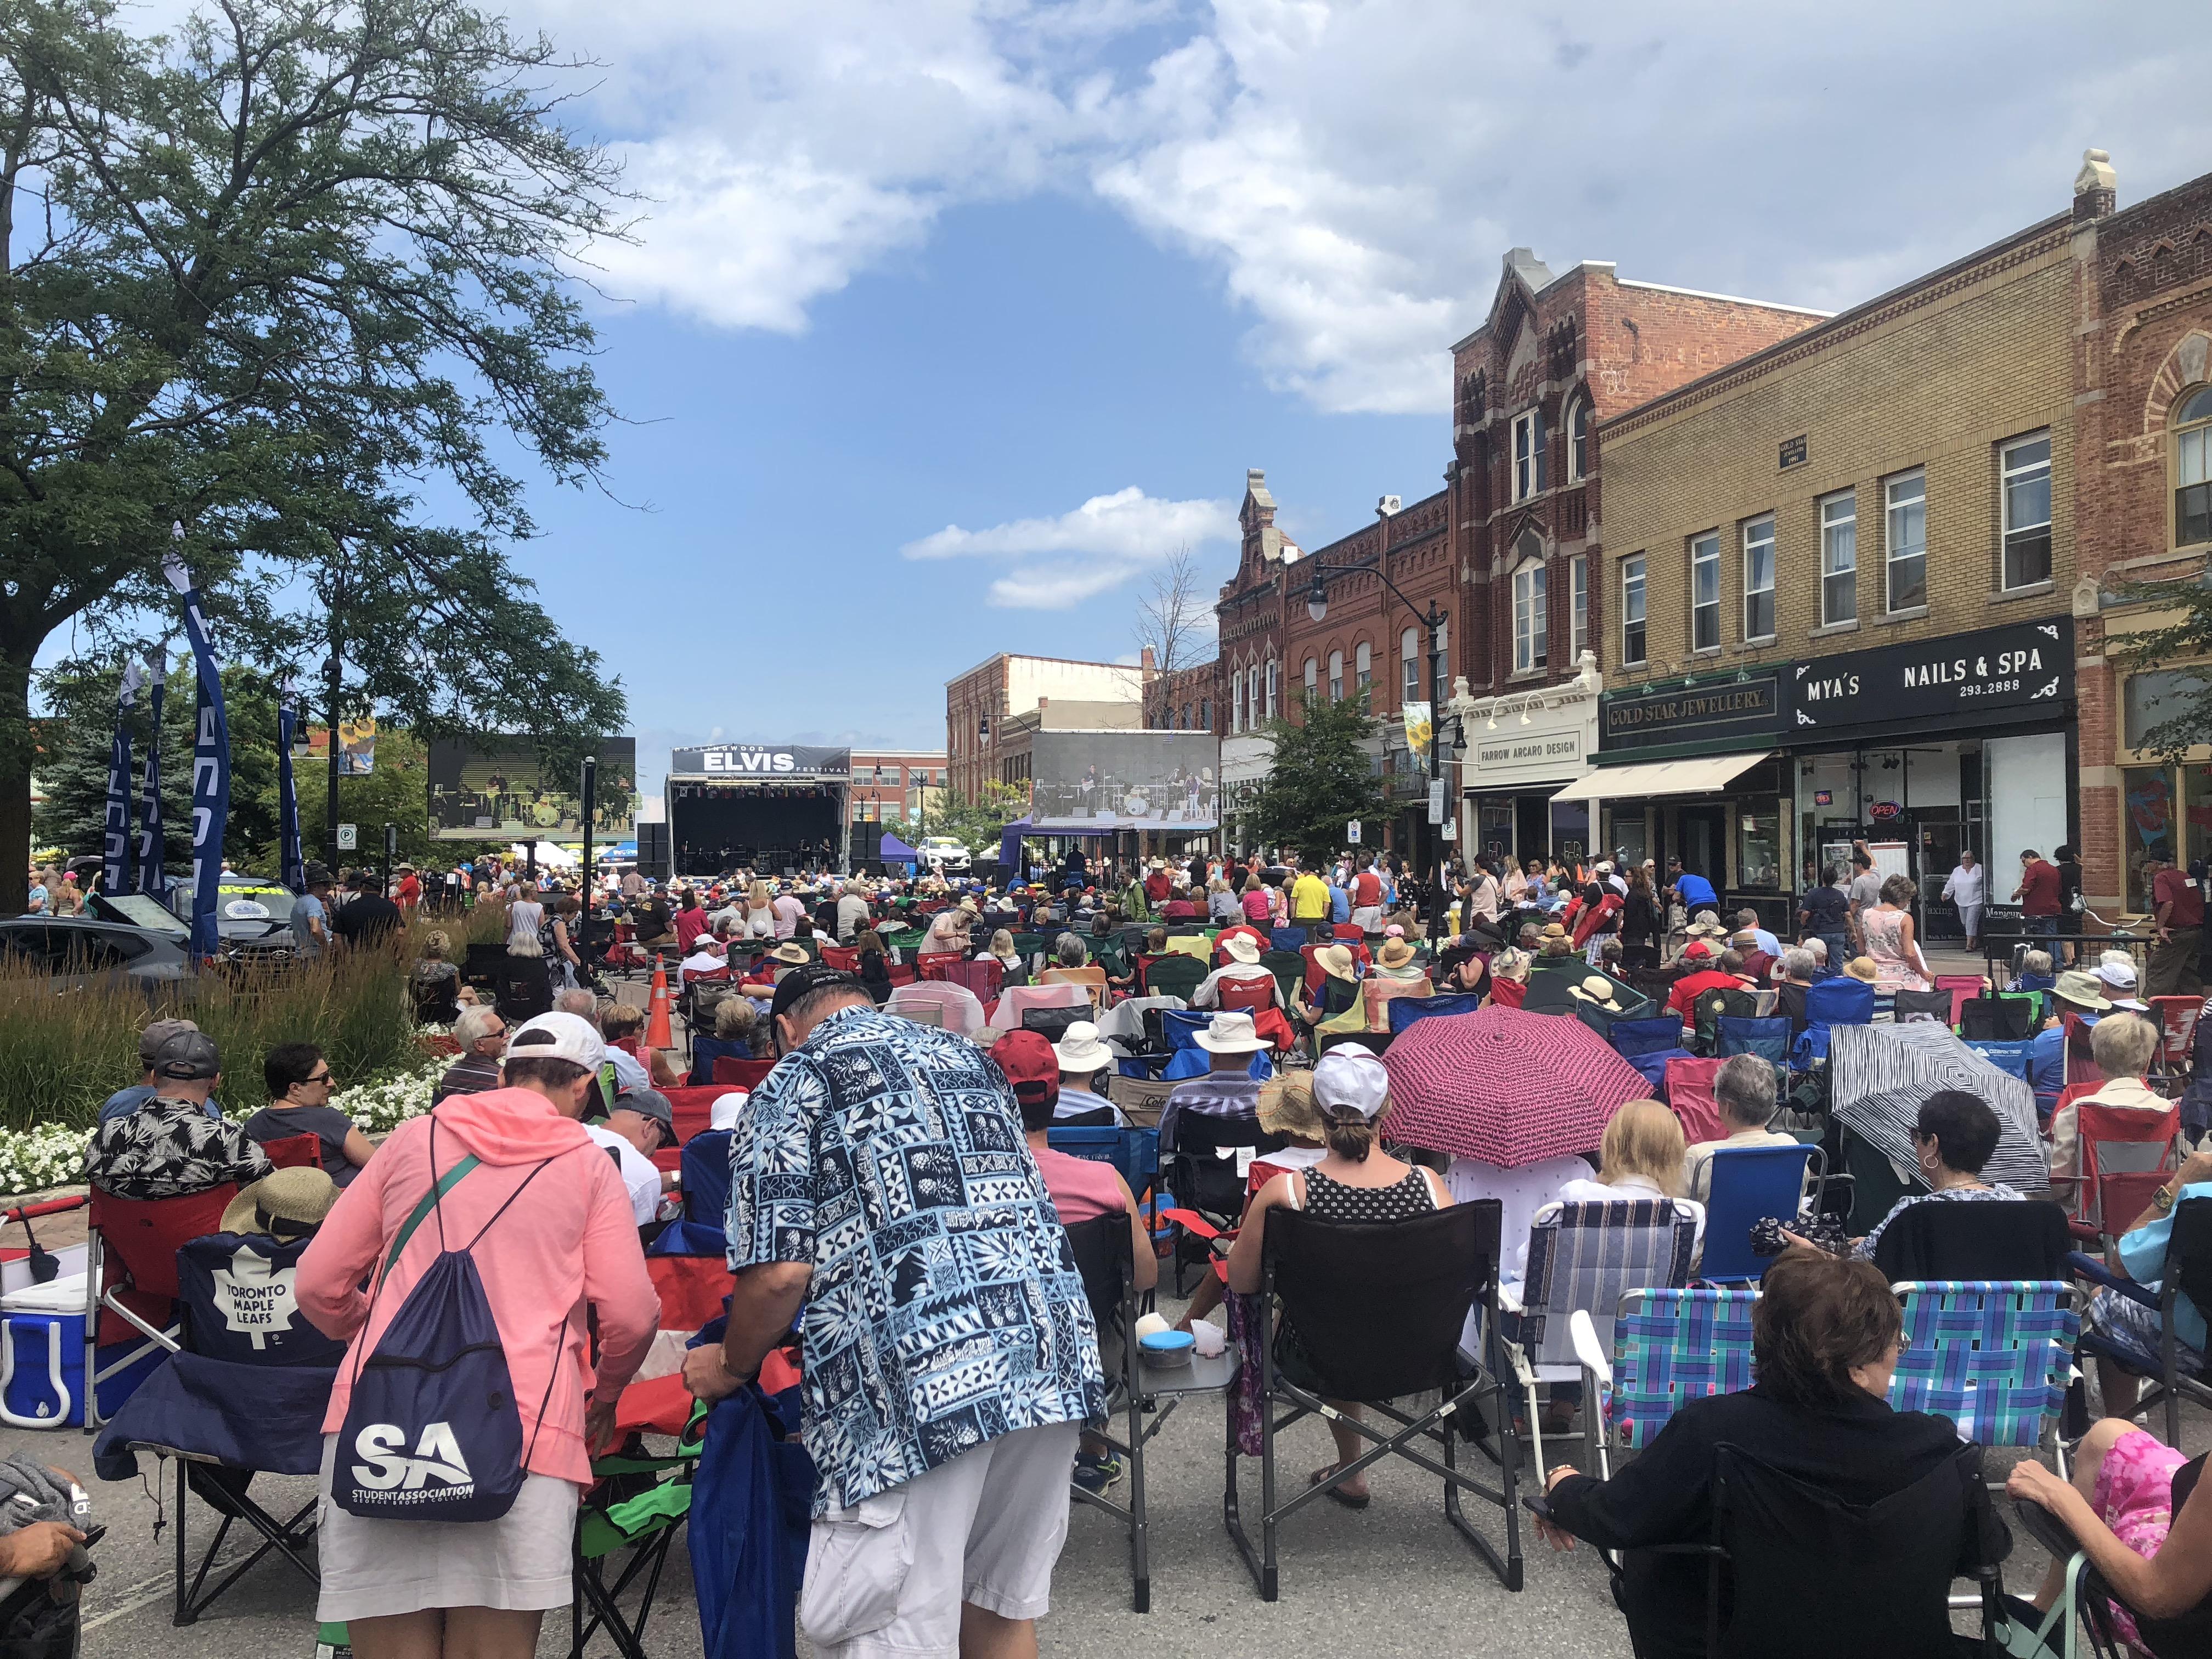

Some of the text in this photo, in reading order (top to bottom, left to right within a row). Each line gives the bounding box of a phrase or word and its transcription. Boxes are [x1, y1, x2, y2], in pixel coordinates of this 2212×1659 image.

[1904, 648, 2042, 688] NAILS & SPA
[1808, 672, 1860, 701] MYA'S
[1610, 707, 1644, 726] GOLD
[1646, 702, 1677, 721] STAR
[1681, 690, 1763, 717] JEWELLERY
[1481, 741, 1575, 761] FARROW ARCARO DESIGN
[704, 752, 794, 771] ELVIS
[1871, 805, 1898, 816] OPEN
[1925, 905, 1954, 917] axing
[1146, 1096, 1166, 1106] Cole
[226, 1283, 286, 1299] TORONTO
[234, 1299, 274, 1312] MAPLE
[236, 1312, 272, 1324] LEAFS
[351, 1421, 473, 1490] SA
[431, 1494, 473, 1503] COLLEGE
